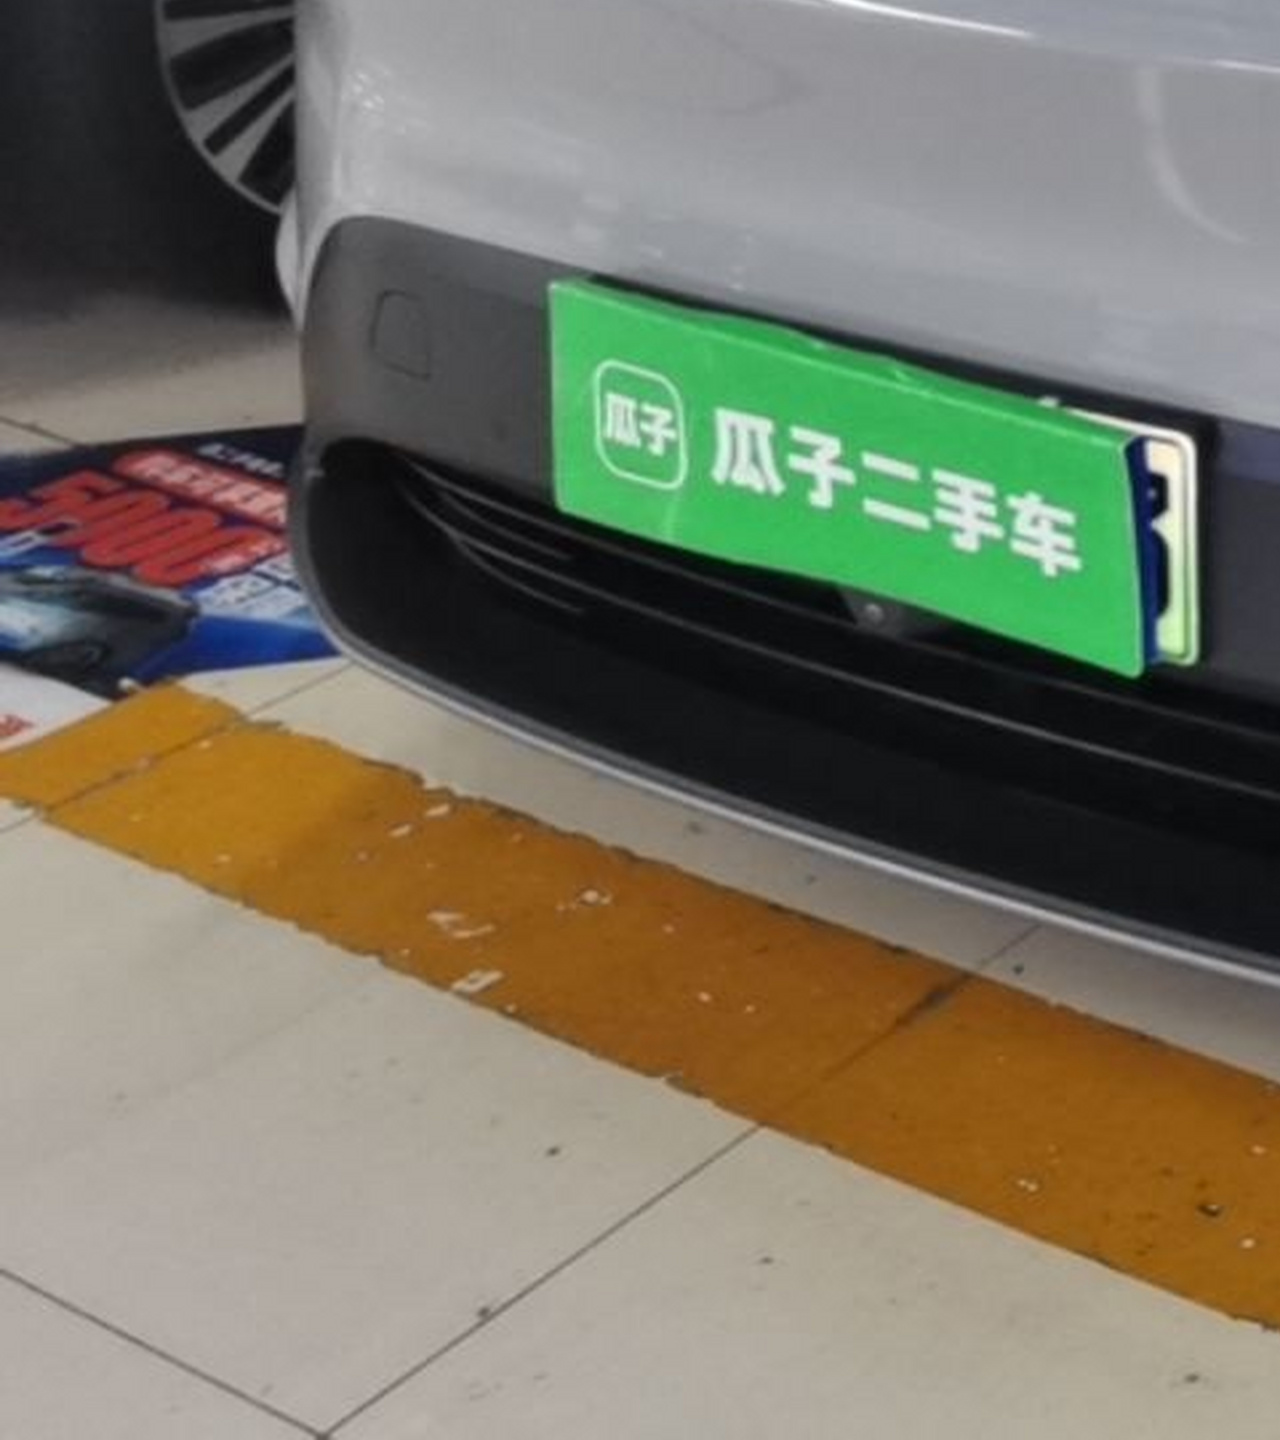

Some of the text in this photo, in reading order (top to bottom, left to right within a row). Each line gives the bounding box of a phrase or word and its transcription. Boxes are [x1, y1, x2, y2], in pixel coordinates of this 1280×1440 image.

[603, 391, 678, 457] 瓜子
[712, 407, 1082, 578] 瓜子二手车
